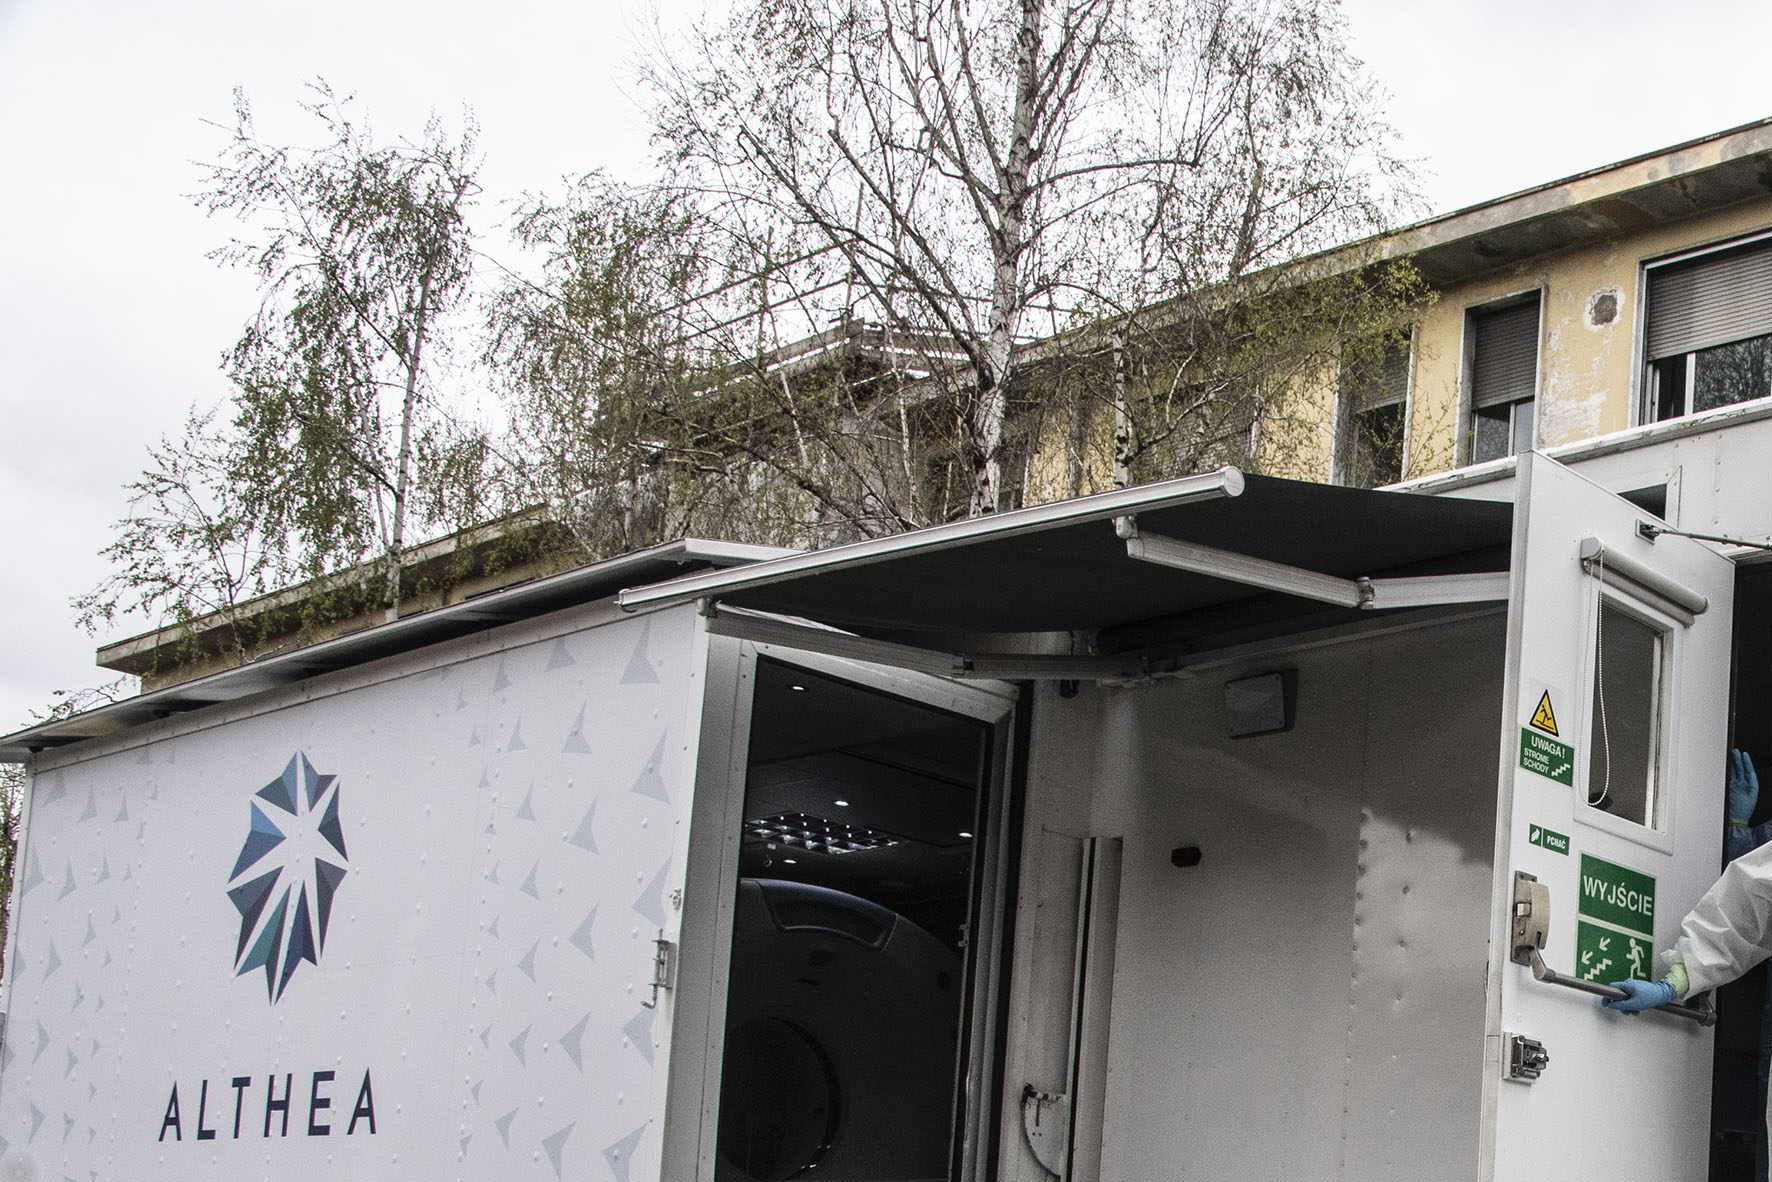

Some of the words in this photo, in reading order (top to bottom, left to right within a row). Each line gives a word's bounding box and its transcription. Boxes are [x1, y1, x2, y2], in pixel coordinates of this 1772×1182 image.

[1523, 747, 1550, 764] STROME
[1531, 735, 1566, 759] UWAGA!
[1522, 757, 1550, 774] SCHODY
[1583, 875, 1653, 917] WYJŚCIE
[157, 1066, 377, 1142] ALTHEA
